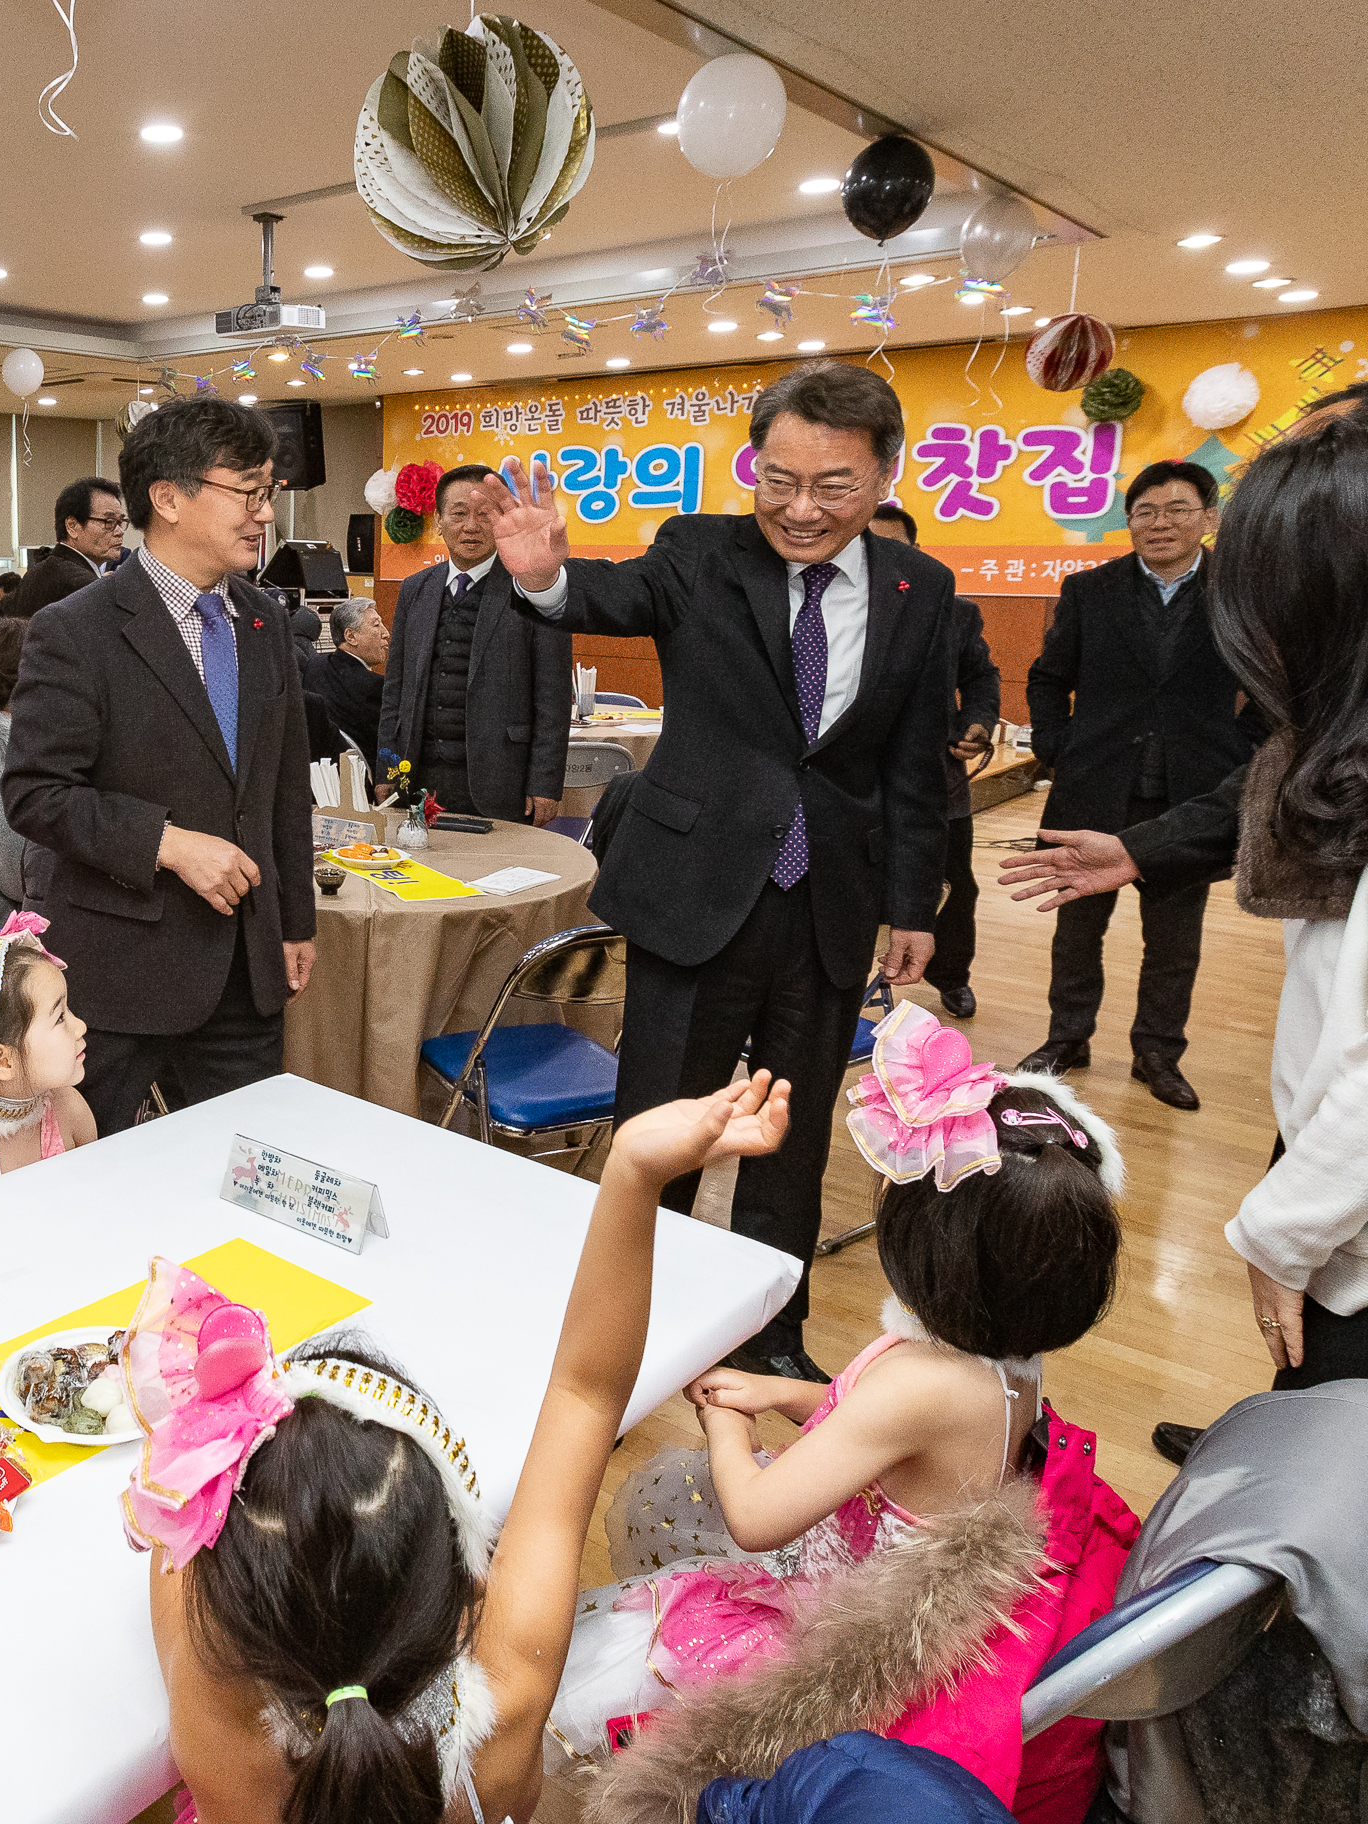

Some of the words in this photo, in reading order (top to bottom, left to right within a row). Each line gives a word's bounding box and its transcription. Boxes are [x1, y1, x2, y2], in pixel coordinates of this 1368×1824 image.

[421, 410, 473, 437] 2019
[480, 399, 565, 435] 희망온돌
[579, 391, 652, 430] 따뜻한
[261, 1149, 282, 1164] 한방차
[257, 1163, 279, 1177] 메밀차
[311, 1184, 338, 1202] 커피믹스
[307, 1195, 336, 1214] 블랙커피
